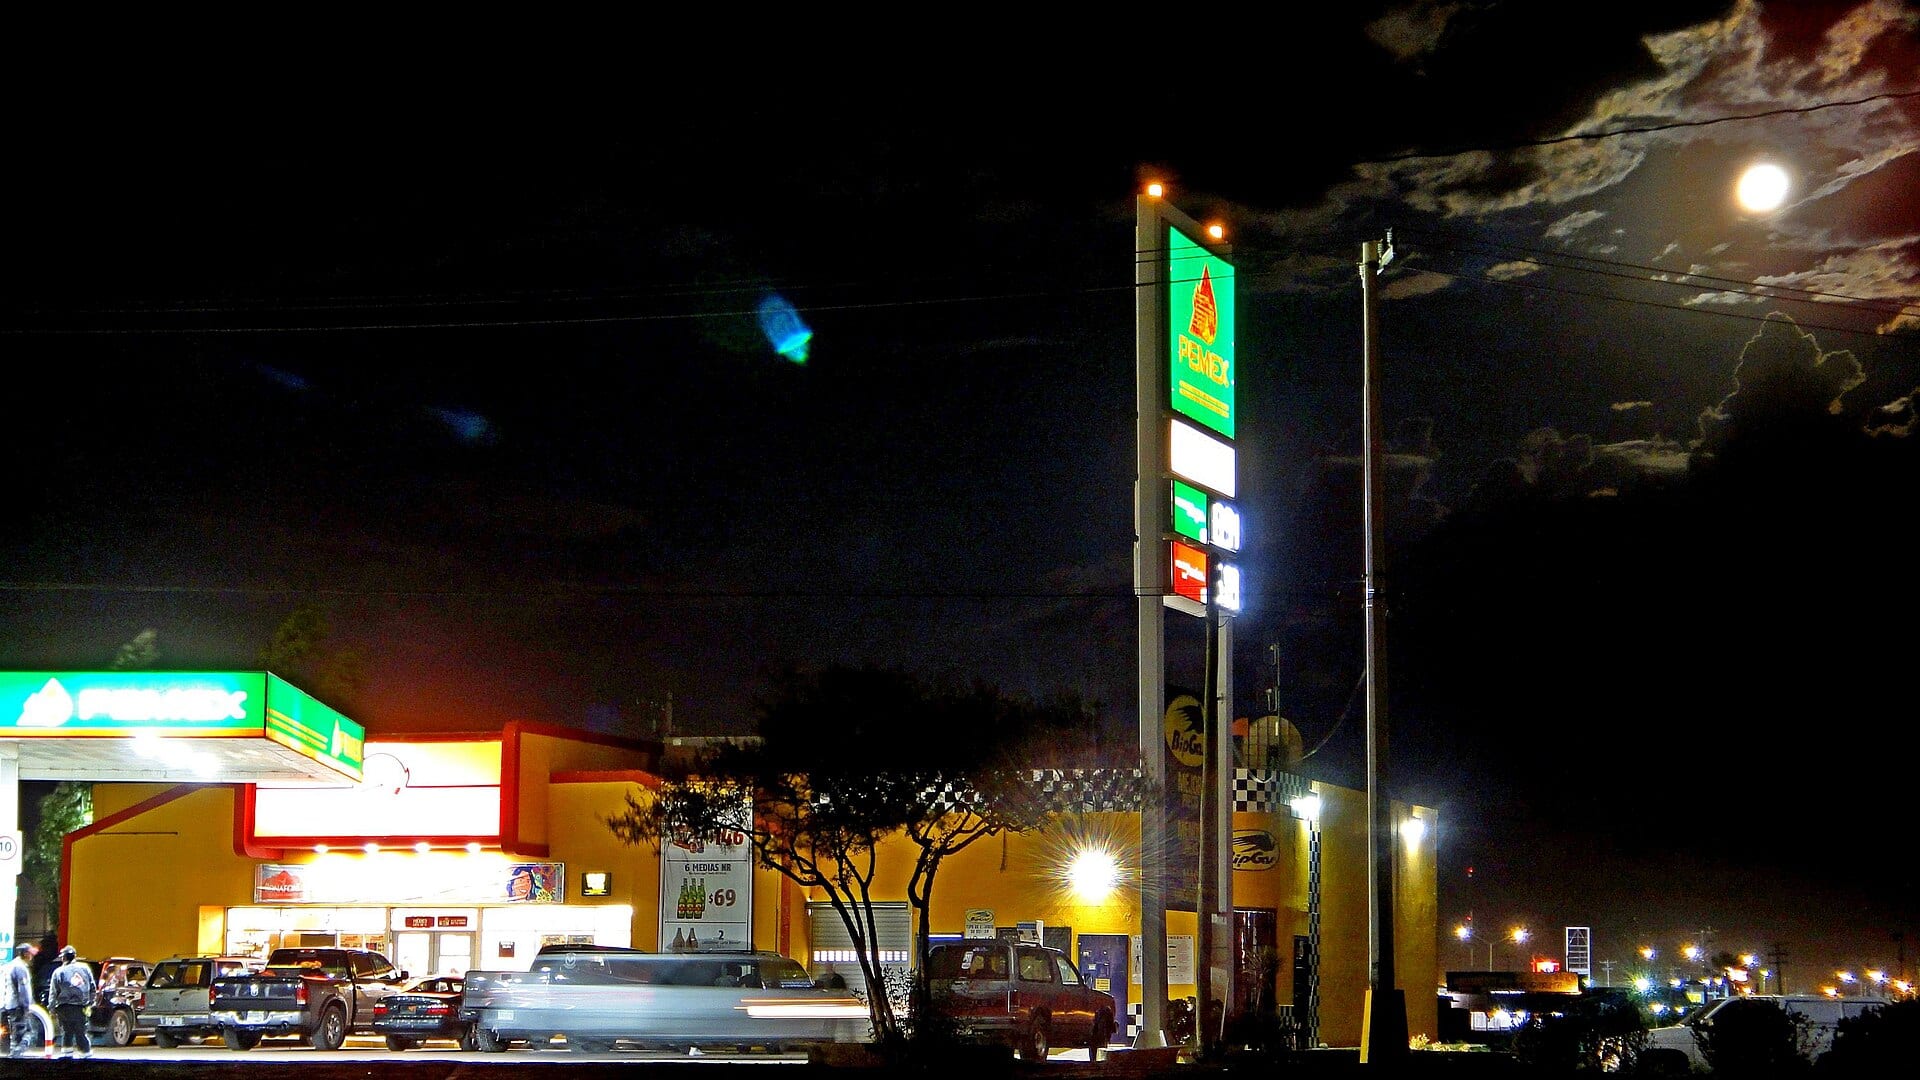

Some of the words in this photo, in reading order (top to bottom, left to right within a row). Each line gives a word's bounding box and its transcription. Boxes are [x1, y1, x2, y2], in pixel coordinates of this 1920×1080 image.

[1178, 334, 1230, 388] PEMEX
[684, 863, 690, 872] 6
[692, 863, 719, 872] MEDIAS
[708, 888, 737, 908] $69
[718, 929, 724, 941] 2
